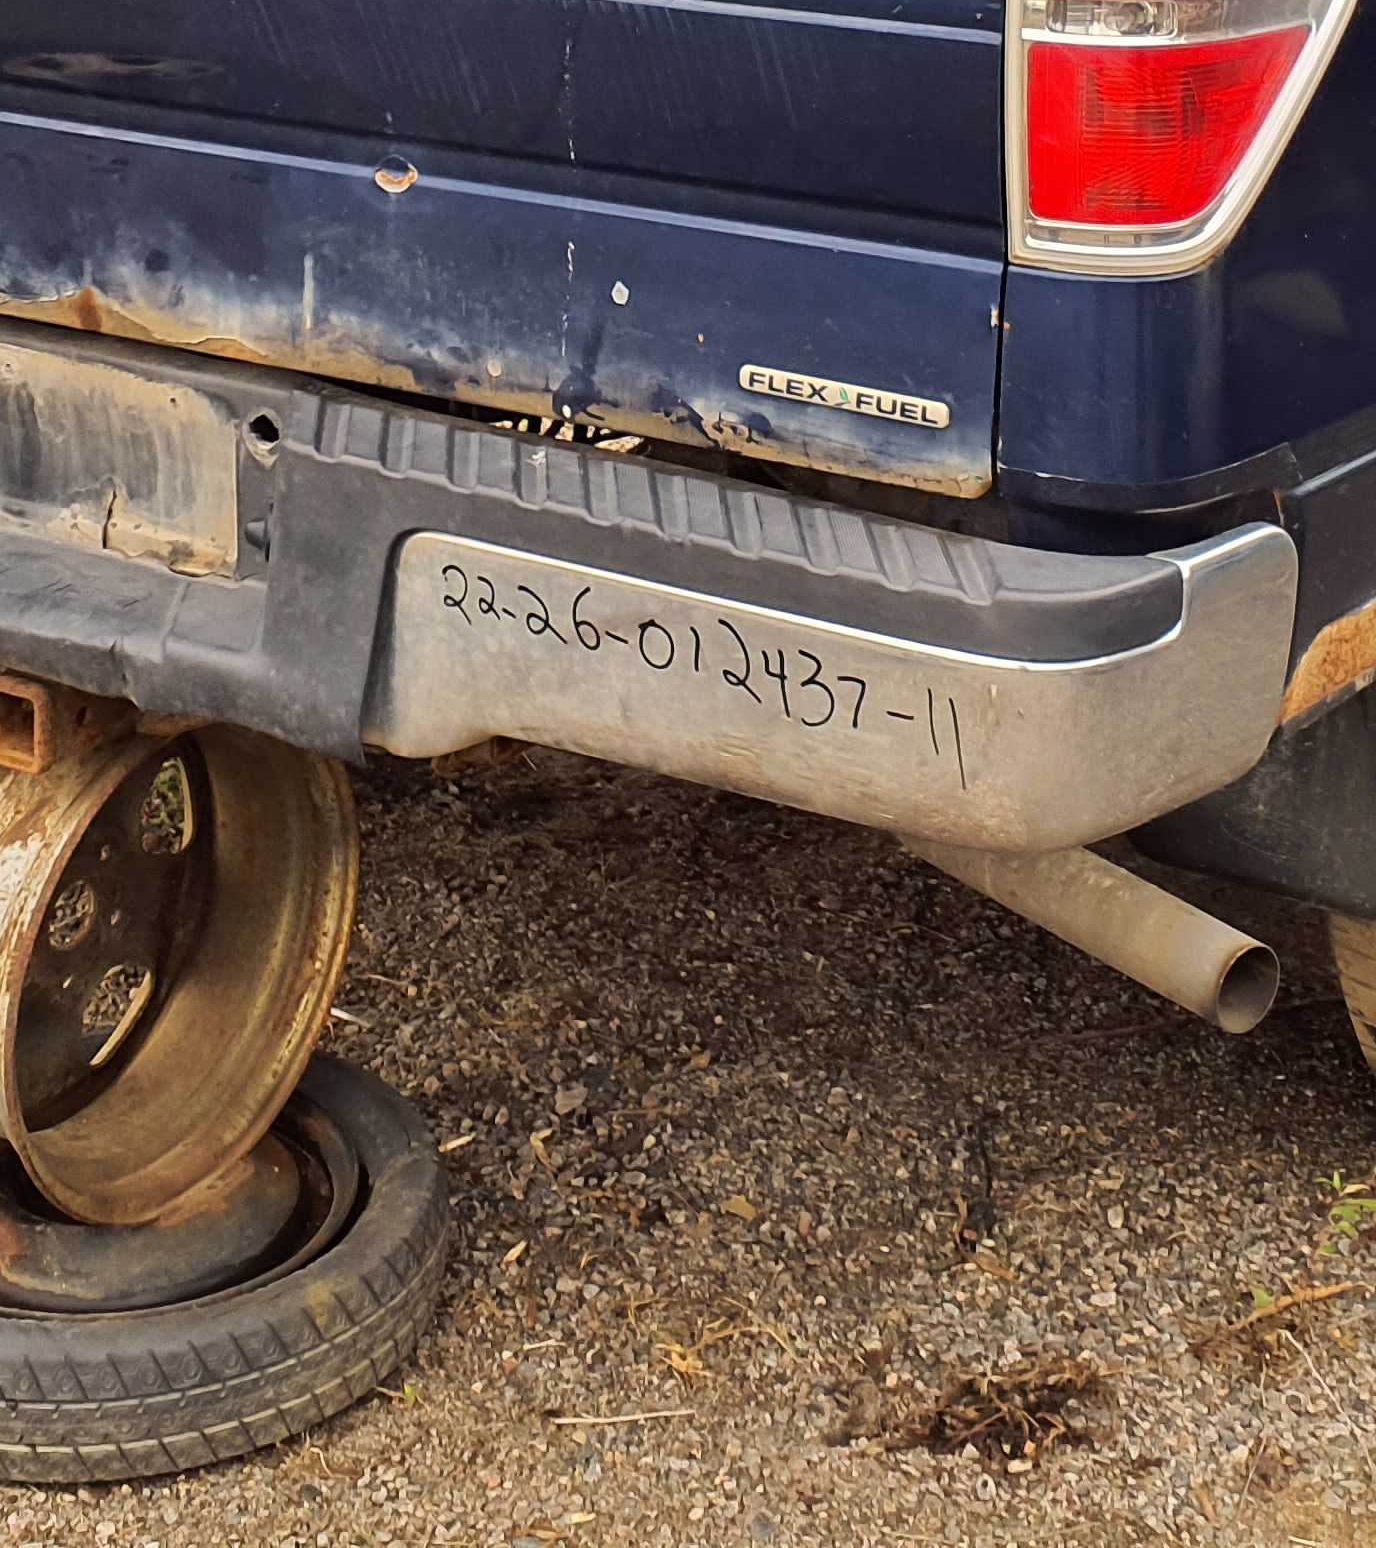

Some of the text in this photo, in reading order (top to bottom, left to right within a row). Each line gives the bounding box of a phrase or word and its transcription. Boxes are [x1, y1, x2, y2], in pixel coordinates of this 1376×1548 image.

[747, 370, 940, 427] FLEX FUEL
[441, 564, 969, 792] 22-26-012437-11
